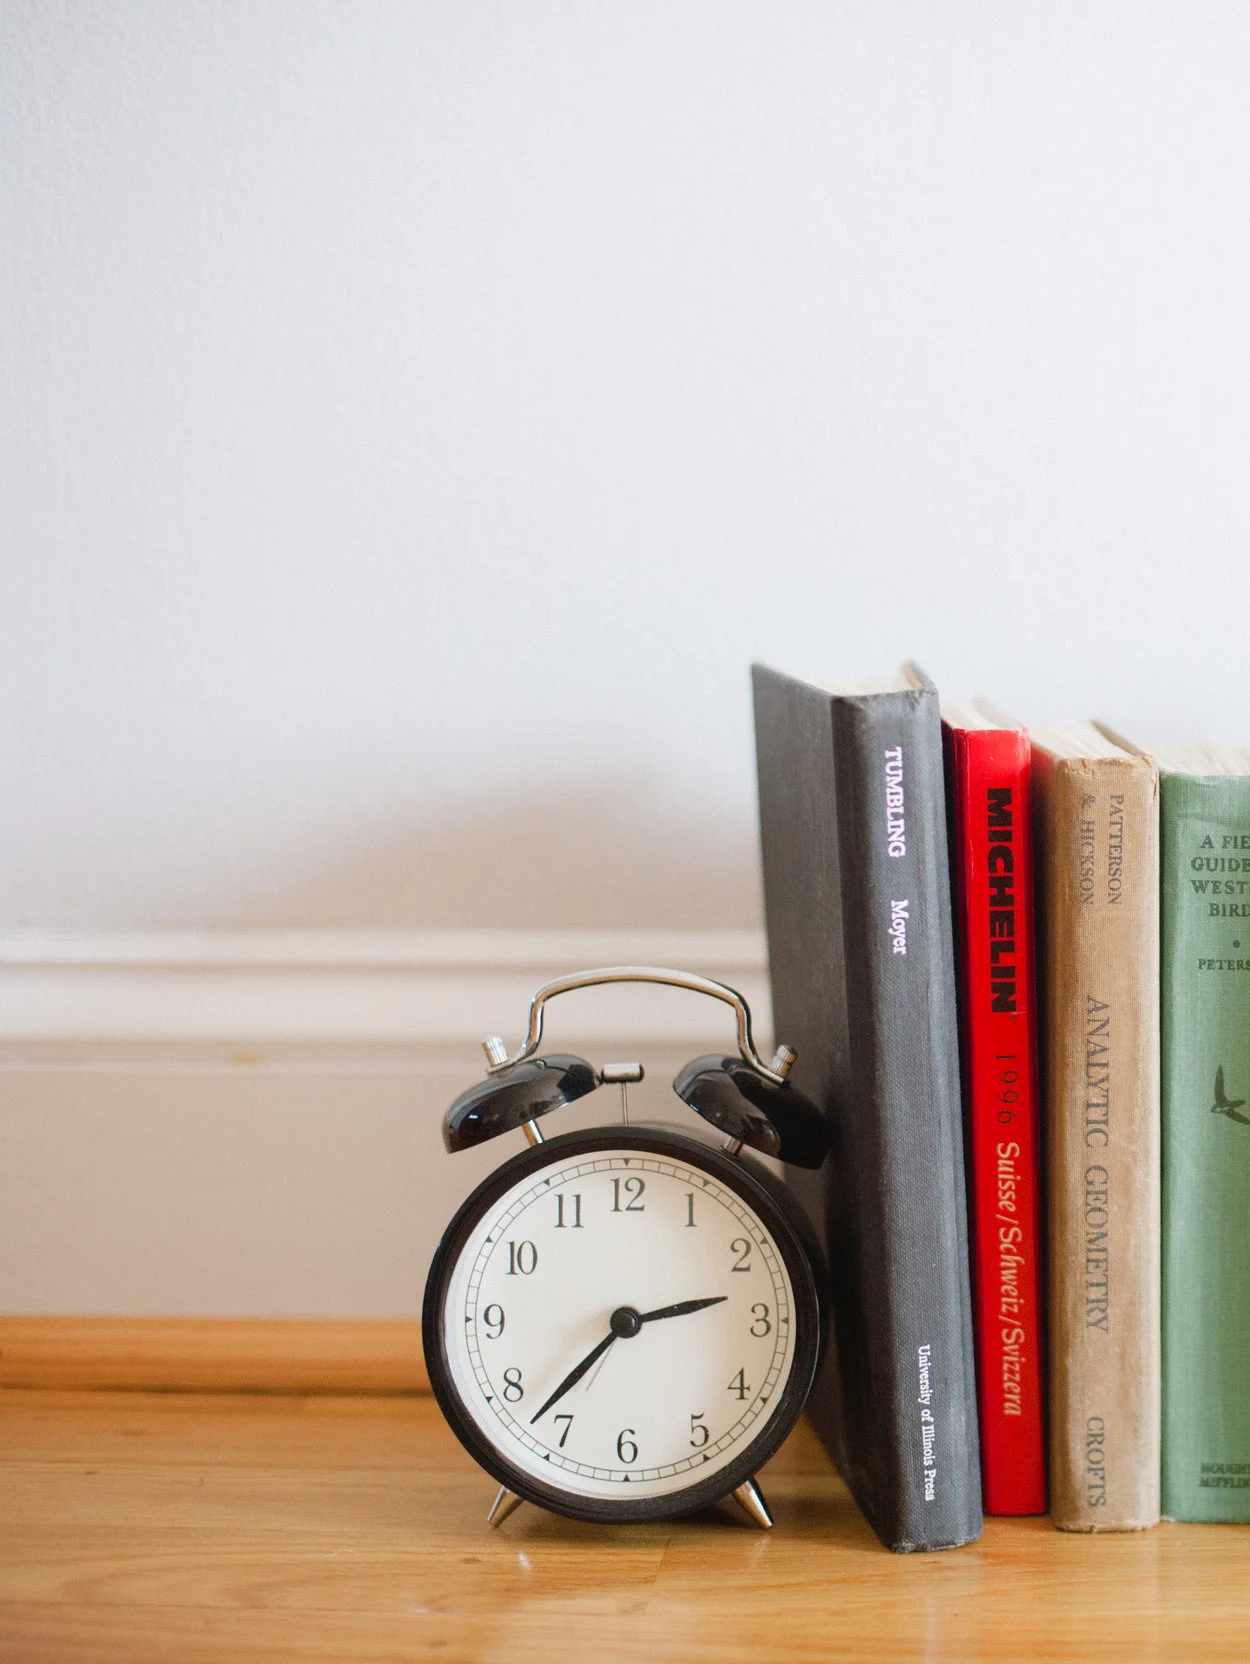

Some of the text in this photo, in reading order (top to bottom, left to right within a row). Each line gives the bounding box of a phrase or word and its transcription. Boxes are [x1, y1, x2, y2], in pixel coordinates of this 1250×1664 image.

[884, 746, 909, 955] TUMBLING Moyer
[1079, 793, 1096, 906] & HICKSON
[1108, 794, 1124, 906] PATTERSON
[1200, 835, 1215, 850] A
[986, 788, 1017, 1013] MICHELIN
[996, 1055, 1019, 1124] 1996
[554, 1194, 585, 1229] 11
[610, 1177, 645, 1212] 12
[684, 1193, 698, 1228] 1
[505, 1240, 538, 1276] 10
[730, 1238, 752, 1272] 2
[1085, 995, 1110, 1508] ANALYTIC GEOMETRY CROFTS
[483, 1304, 505, 1339] 9
[750, 1303, 772, 1338] 3
[503, 1367, 524, 1403] 8
[727, 1367, 751, 1400] 4
[553, 1414, 574, 1448] 7
[690, 1413, 710, 1448] 5
[917, 1344, 937, 1501] University of Illinois Press
[616, 1428, 638, 1464] 6
